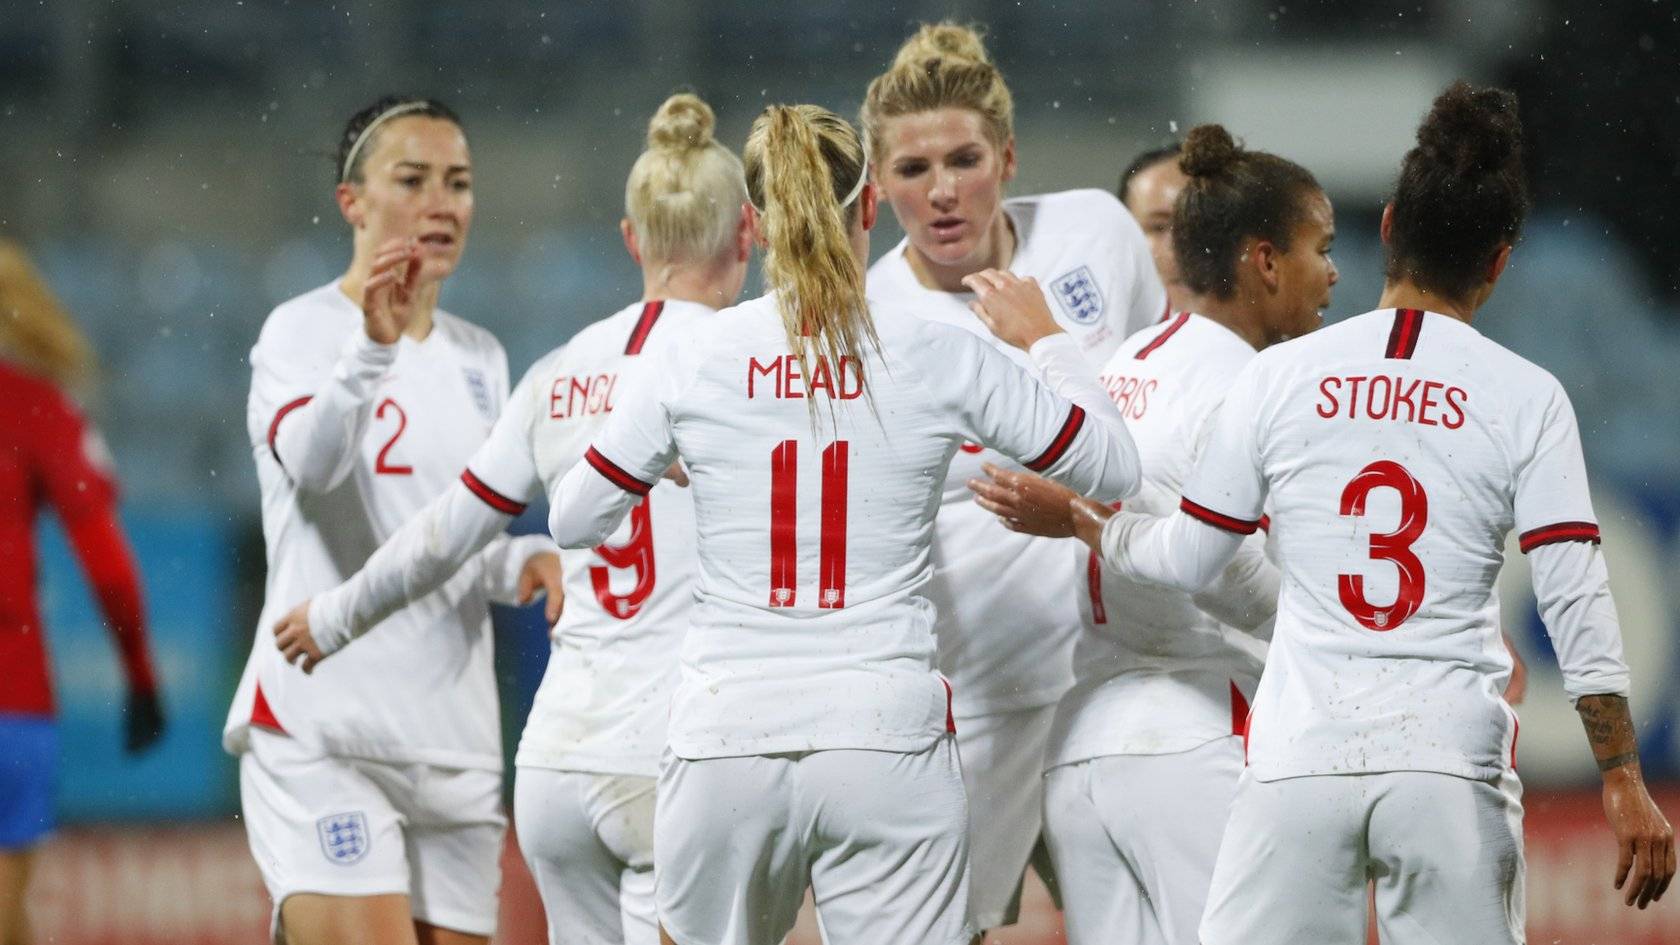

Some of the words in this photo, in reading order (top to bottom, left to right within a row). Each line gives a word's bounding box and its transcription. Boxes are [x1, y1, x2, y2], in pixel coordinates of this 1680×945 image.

[748, 354, 864, 400] MEAD
[1316, 375, 1468, 430] STOKES
[375, 397, 414, 475] 2
[769, 440, 849, 609] 11
[1338, 460, 1429, 632] 3
